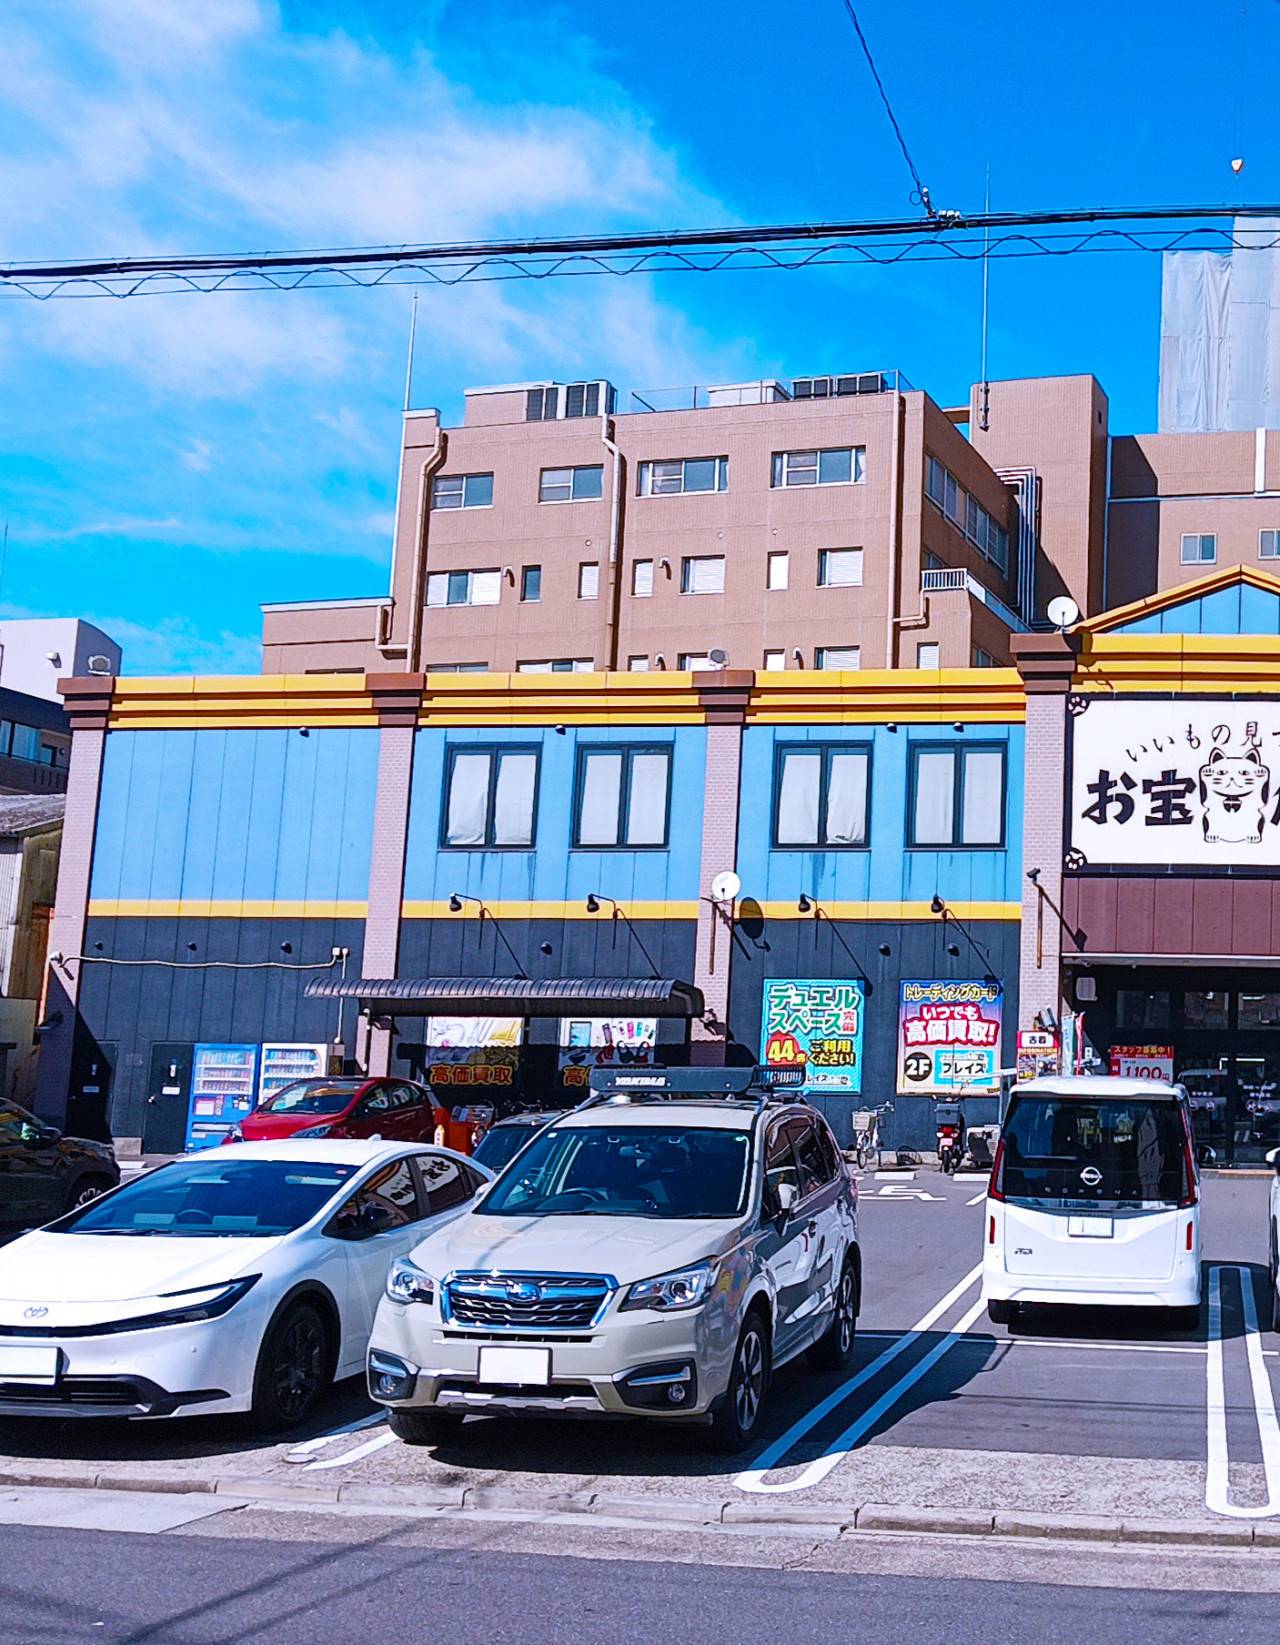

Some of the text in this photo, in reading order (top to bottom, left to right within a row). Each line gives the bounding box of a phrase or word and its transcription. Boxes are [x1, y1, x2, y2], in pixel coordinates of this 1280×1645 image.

[1082, 768, 1197, 827] お宝
[769, 985, 858, 1010] デュエル
[904, 984, 998, 1000] トレーディングカード
[769, 1010, 842, 1032] スペース
[921, 1006, 978, 1020] いつでも
[809, 1039, 852, 1053] ご利用
[430, 1065, 513, 1085] 高価買取
[906, 1059, 931, 1076] 2F
